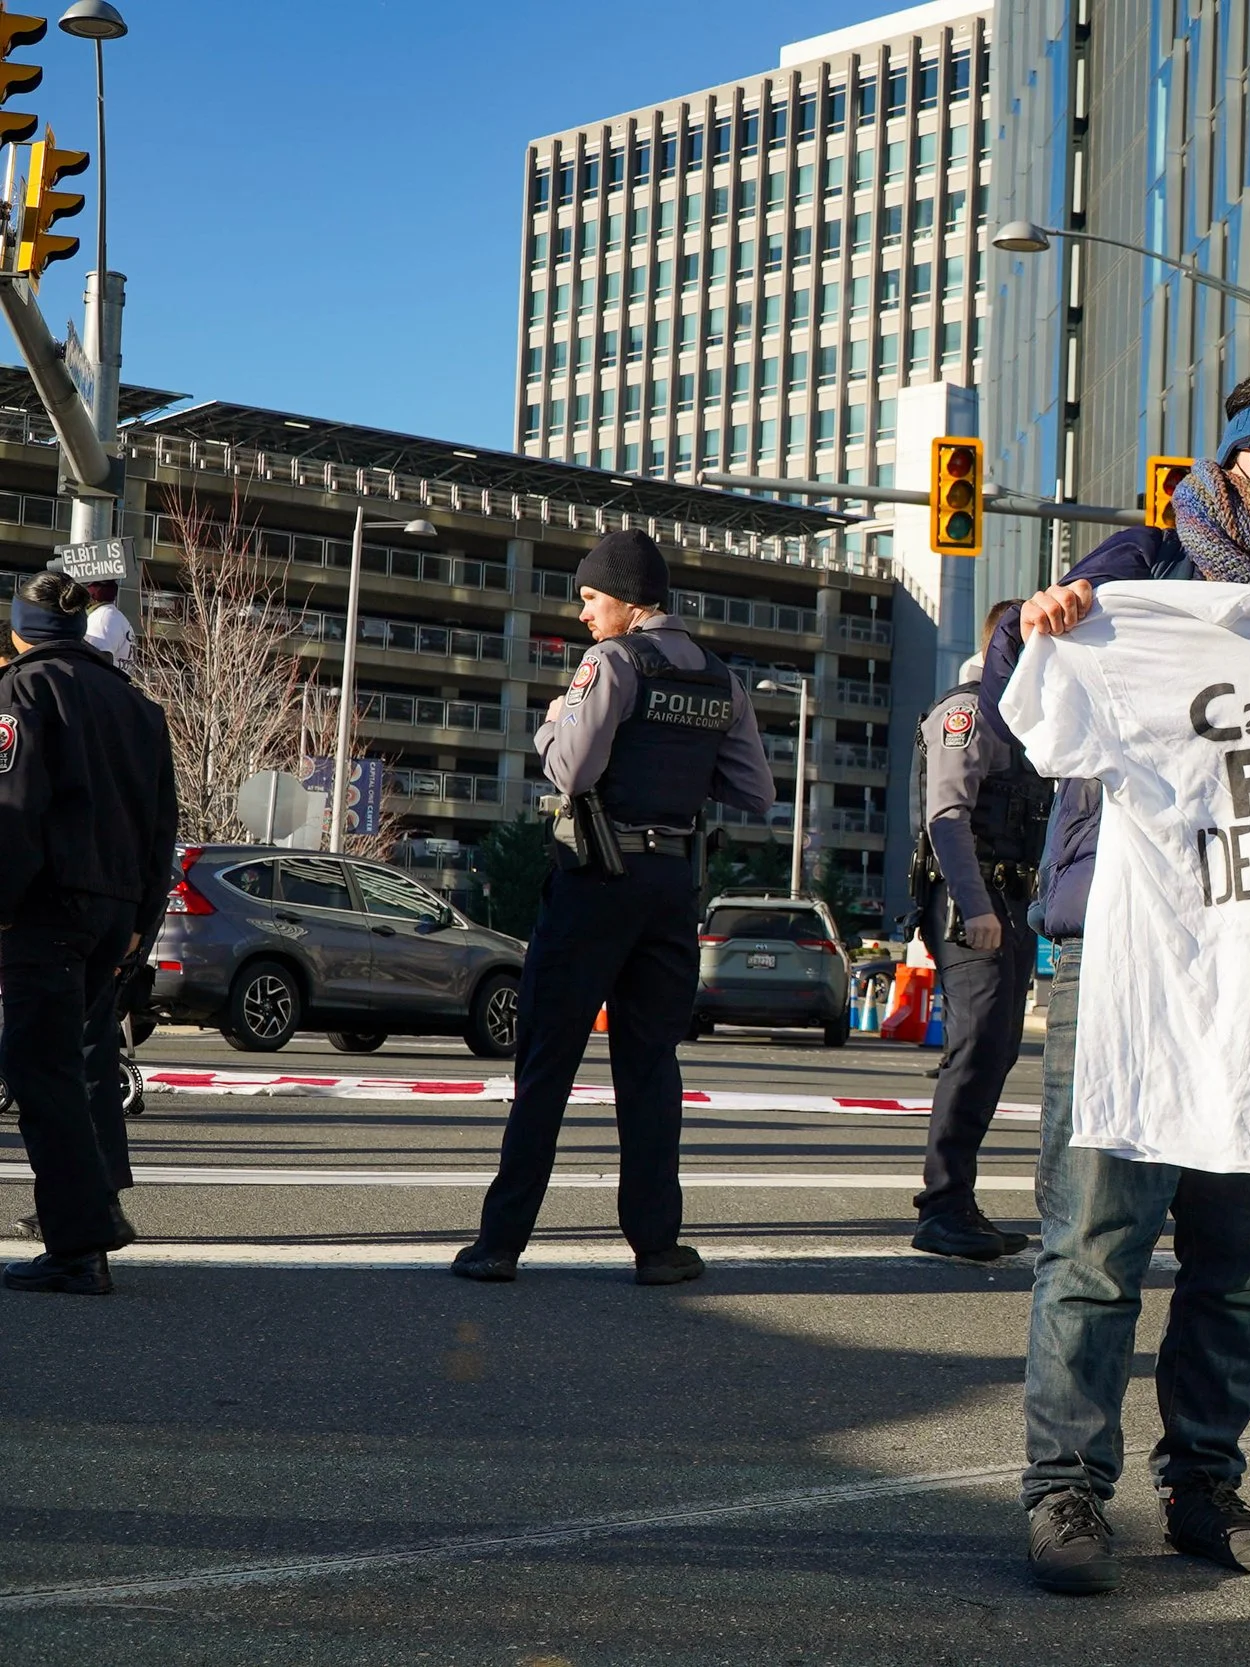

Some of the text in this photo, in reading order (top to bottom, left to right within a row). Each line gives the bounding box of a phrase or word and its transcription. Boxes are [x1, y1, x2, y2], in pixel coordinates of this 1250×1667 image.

[63, 542, 121, 565] ELBIT IS
[62, 559, 125, 578] WATCHING
[649, 691, 731, 719] POLICE
[647, 710, 724, 728] FAIRFAX COUN
